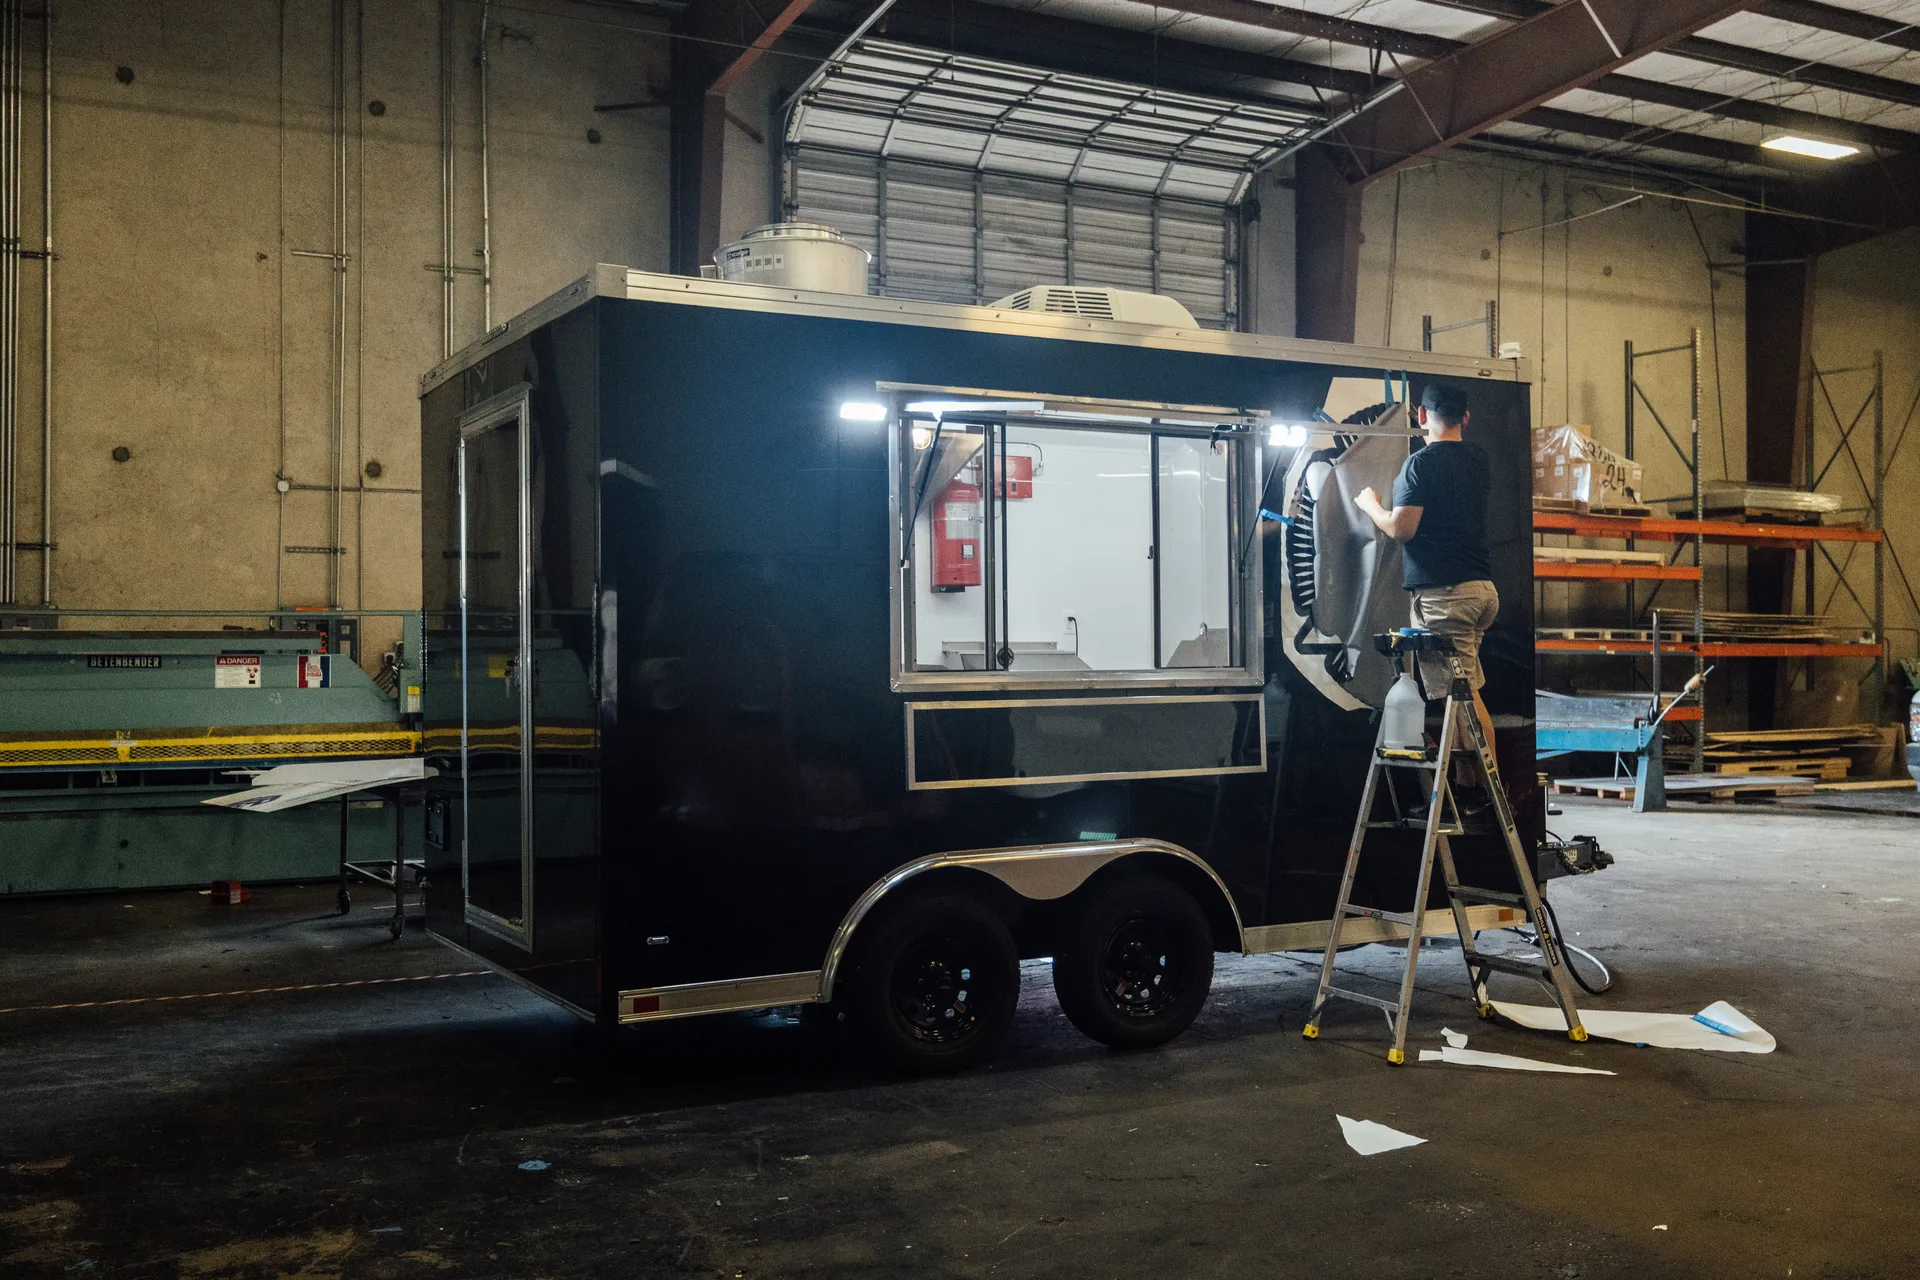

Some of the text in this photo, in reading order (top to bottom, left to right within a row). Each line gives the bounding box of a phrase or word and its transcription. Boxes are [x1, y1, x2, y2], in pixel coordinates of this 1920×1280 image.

[1602, 464, 1626, 496] 24
[91, 656, 159, 667] BETENBENDER
[1536, 908, 1546, 932] GORILLA
